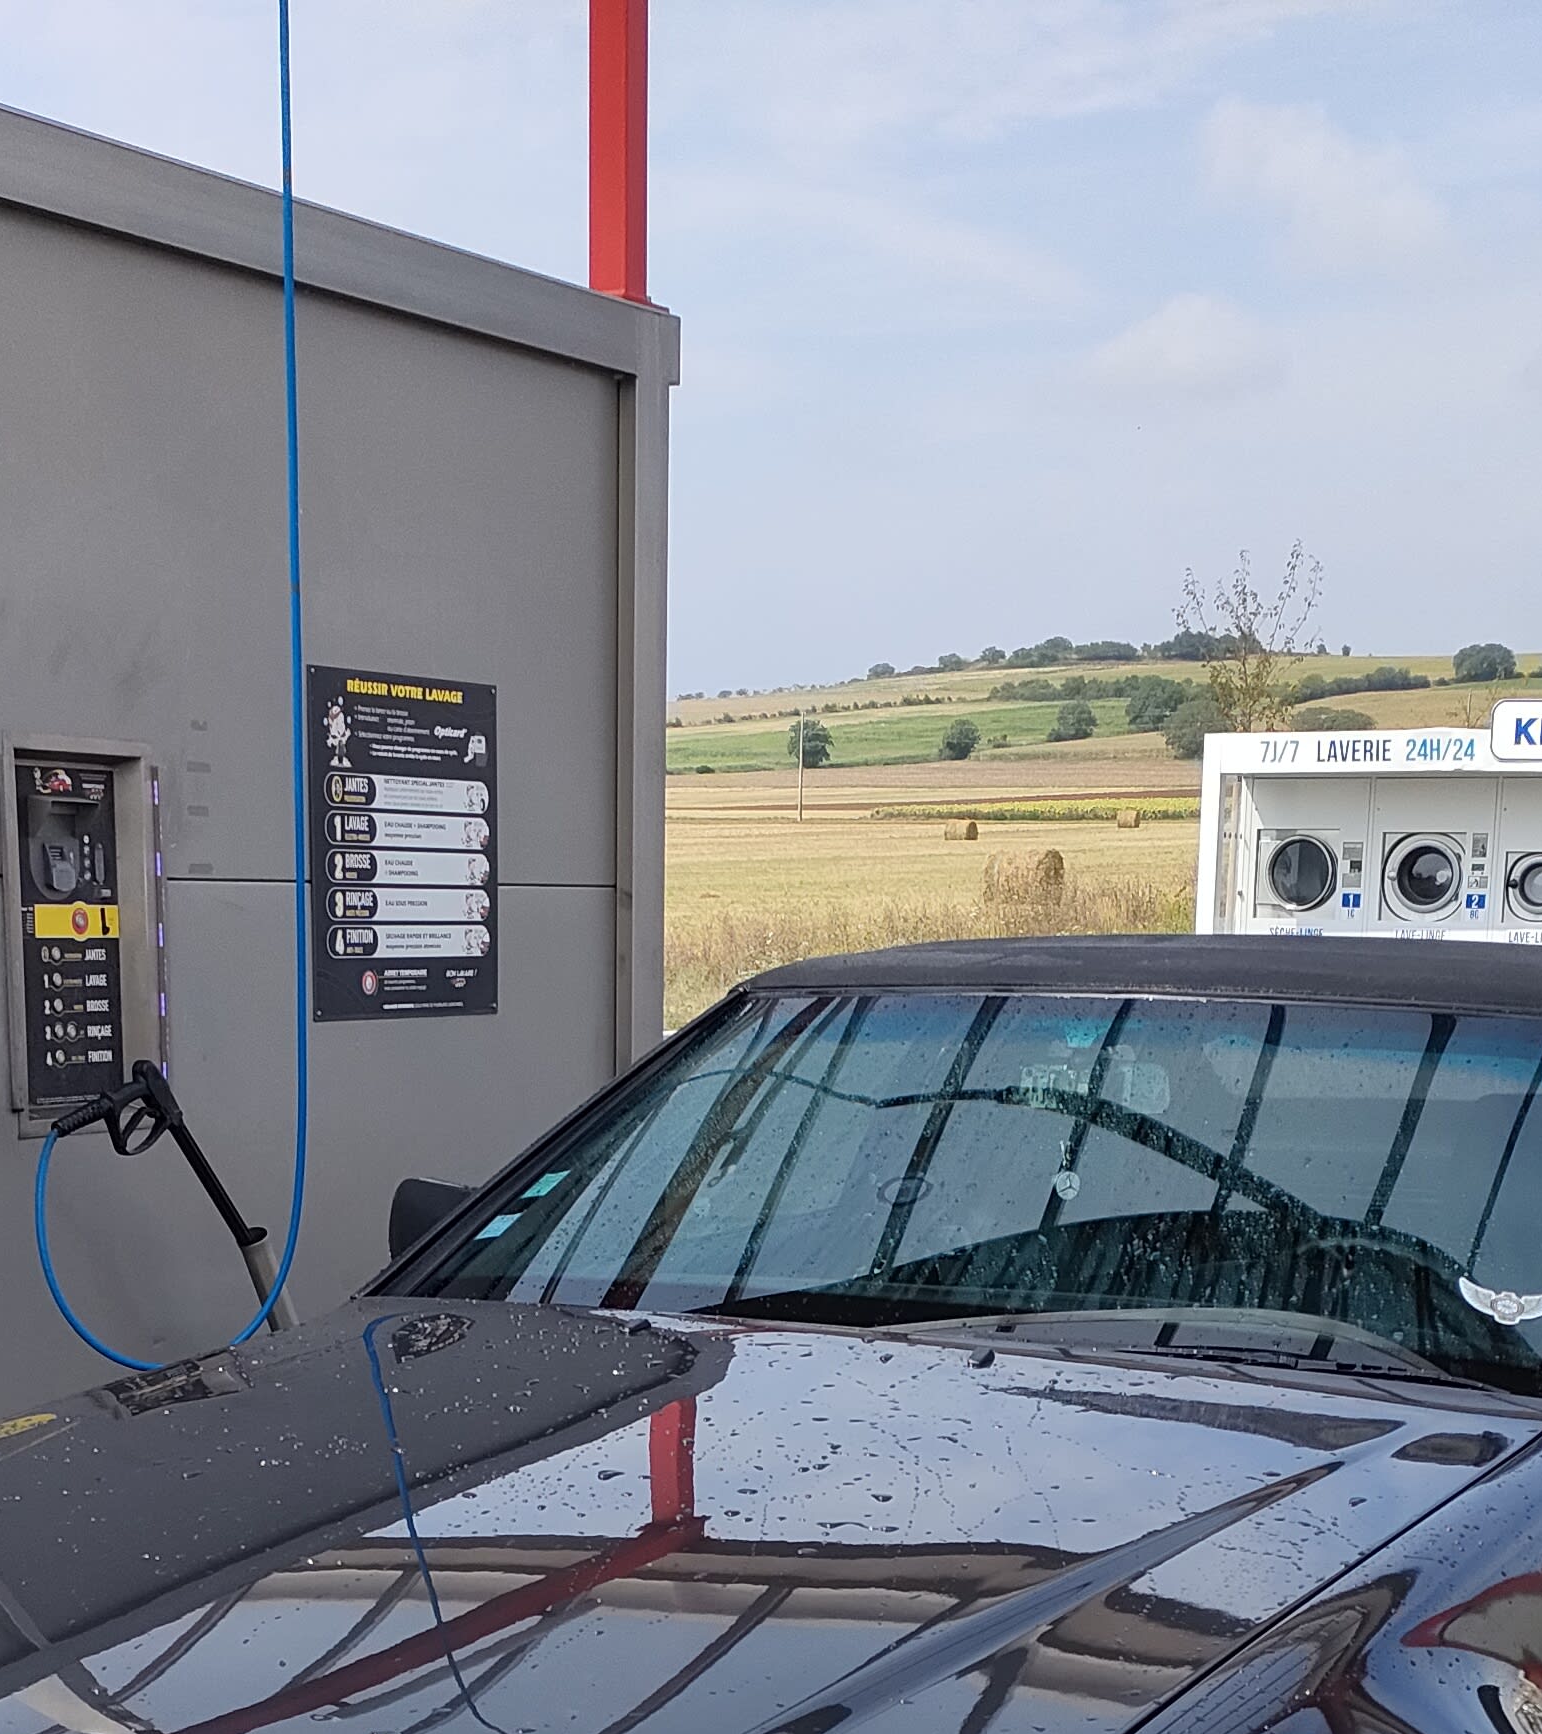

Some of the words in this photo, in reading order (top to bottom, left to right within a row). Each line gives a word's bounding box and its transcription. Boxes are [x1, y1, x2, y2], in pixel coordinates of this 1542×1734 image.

[347, 678, 388, 696] RÉUSSIR
[390, 684, 423, 700] VOTRE
[425, 687, 463, 704] LAVAGE
[1260, 740, 1300, 763] 7J/7
[1317, 740, 1392, 762] LAVERIE
[1405, 738, 1476, 761] 24H/24
[344, 776, 369, 793] JANTES
[345, 815, 369, 831] LAVAGE
[335, 853, 343, 880] 2
[345, 853, 371, 869] BROSSE
[1471, 895, 1479, 908] 2
[346, 928, 373, 944] FINITION
[84, 948, 107, 960] JANTES
[85, 974, 107, 986] LAVAGE
[87, 1000, 109, 1012] BROSSE
[87, 1024, 113, 1040] RINÇAGE
[88, 1050, 113, 1062] FINITION
